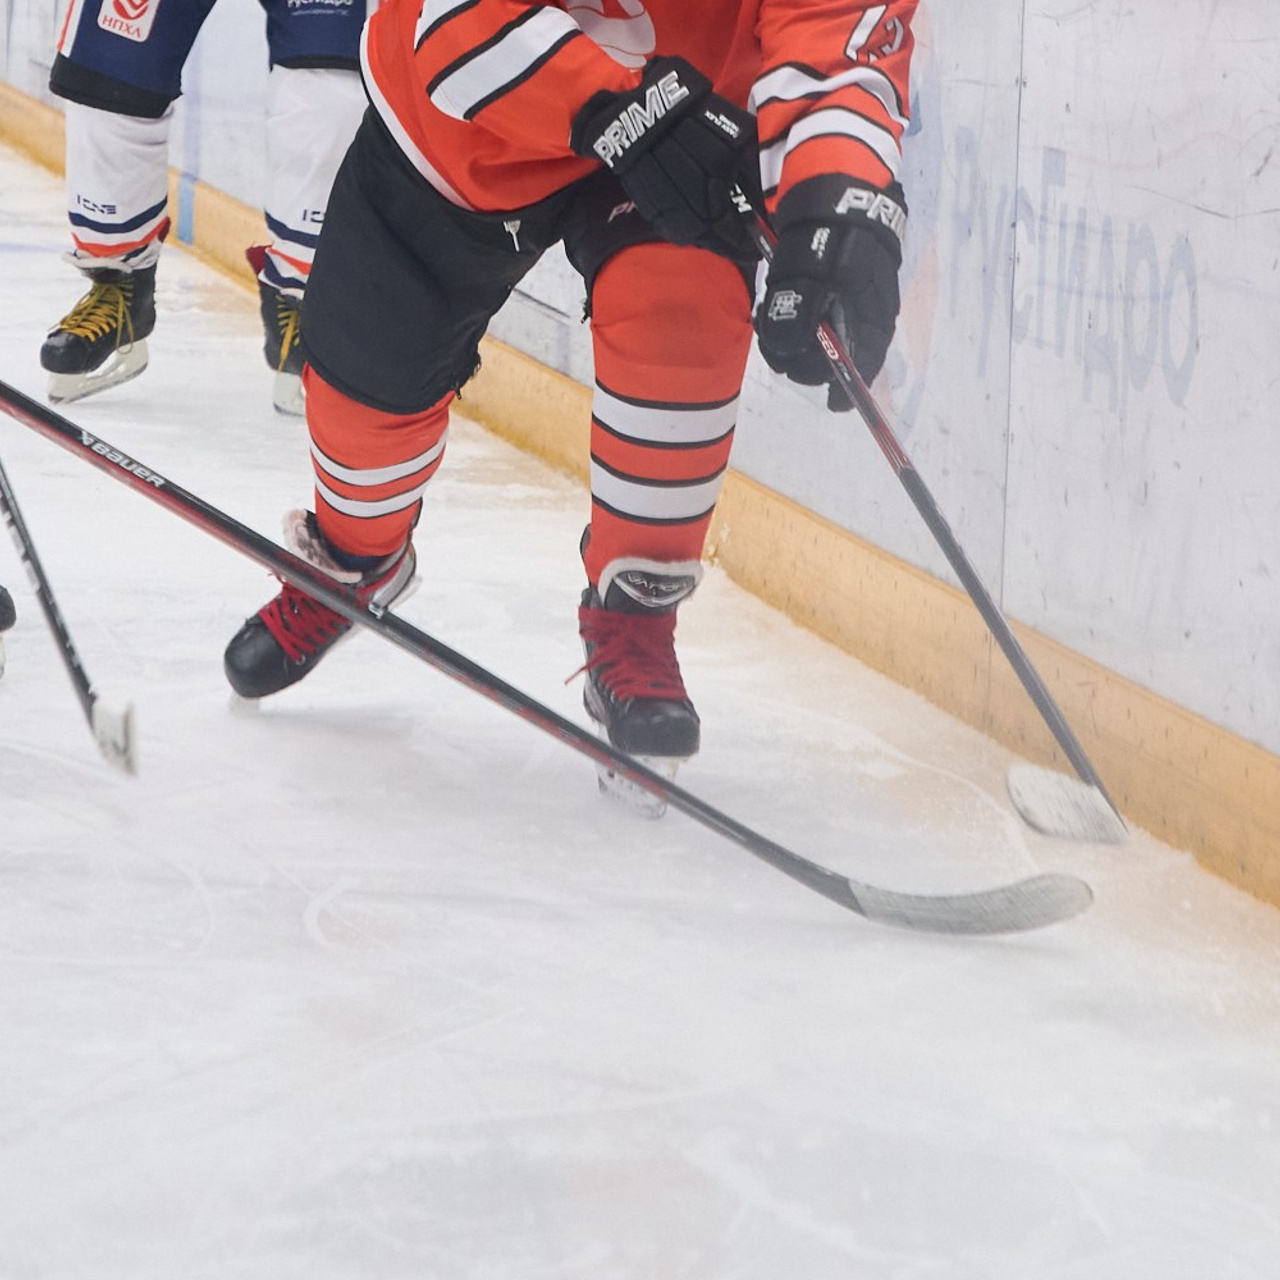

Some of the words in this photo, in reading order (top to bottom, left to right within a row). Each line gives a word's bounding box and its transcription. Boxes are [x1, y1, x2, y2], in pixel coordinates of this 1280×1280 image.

[102, 14, 142, 39] НПХЛ
[593, 70, 690, 168] PRIME
[90, 440, 166, 489] BAUER
